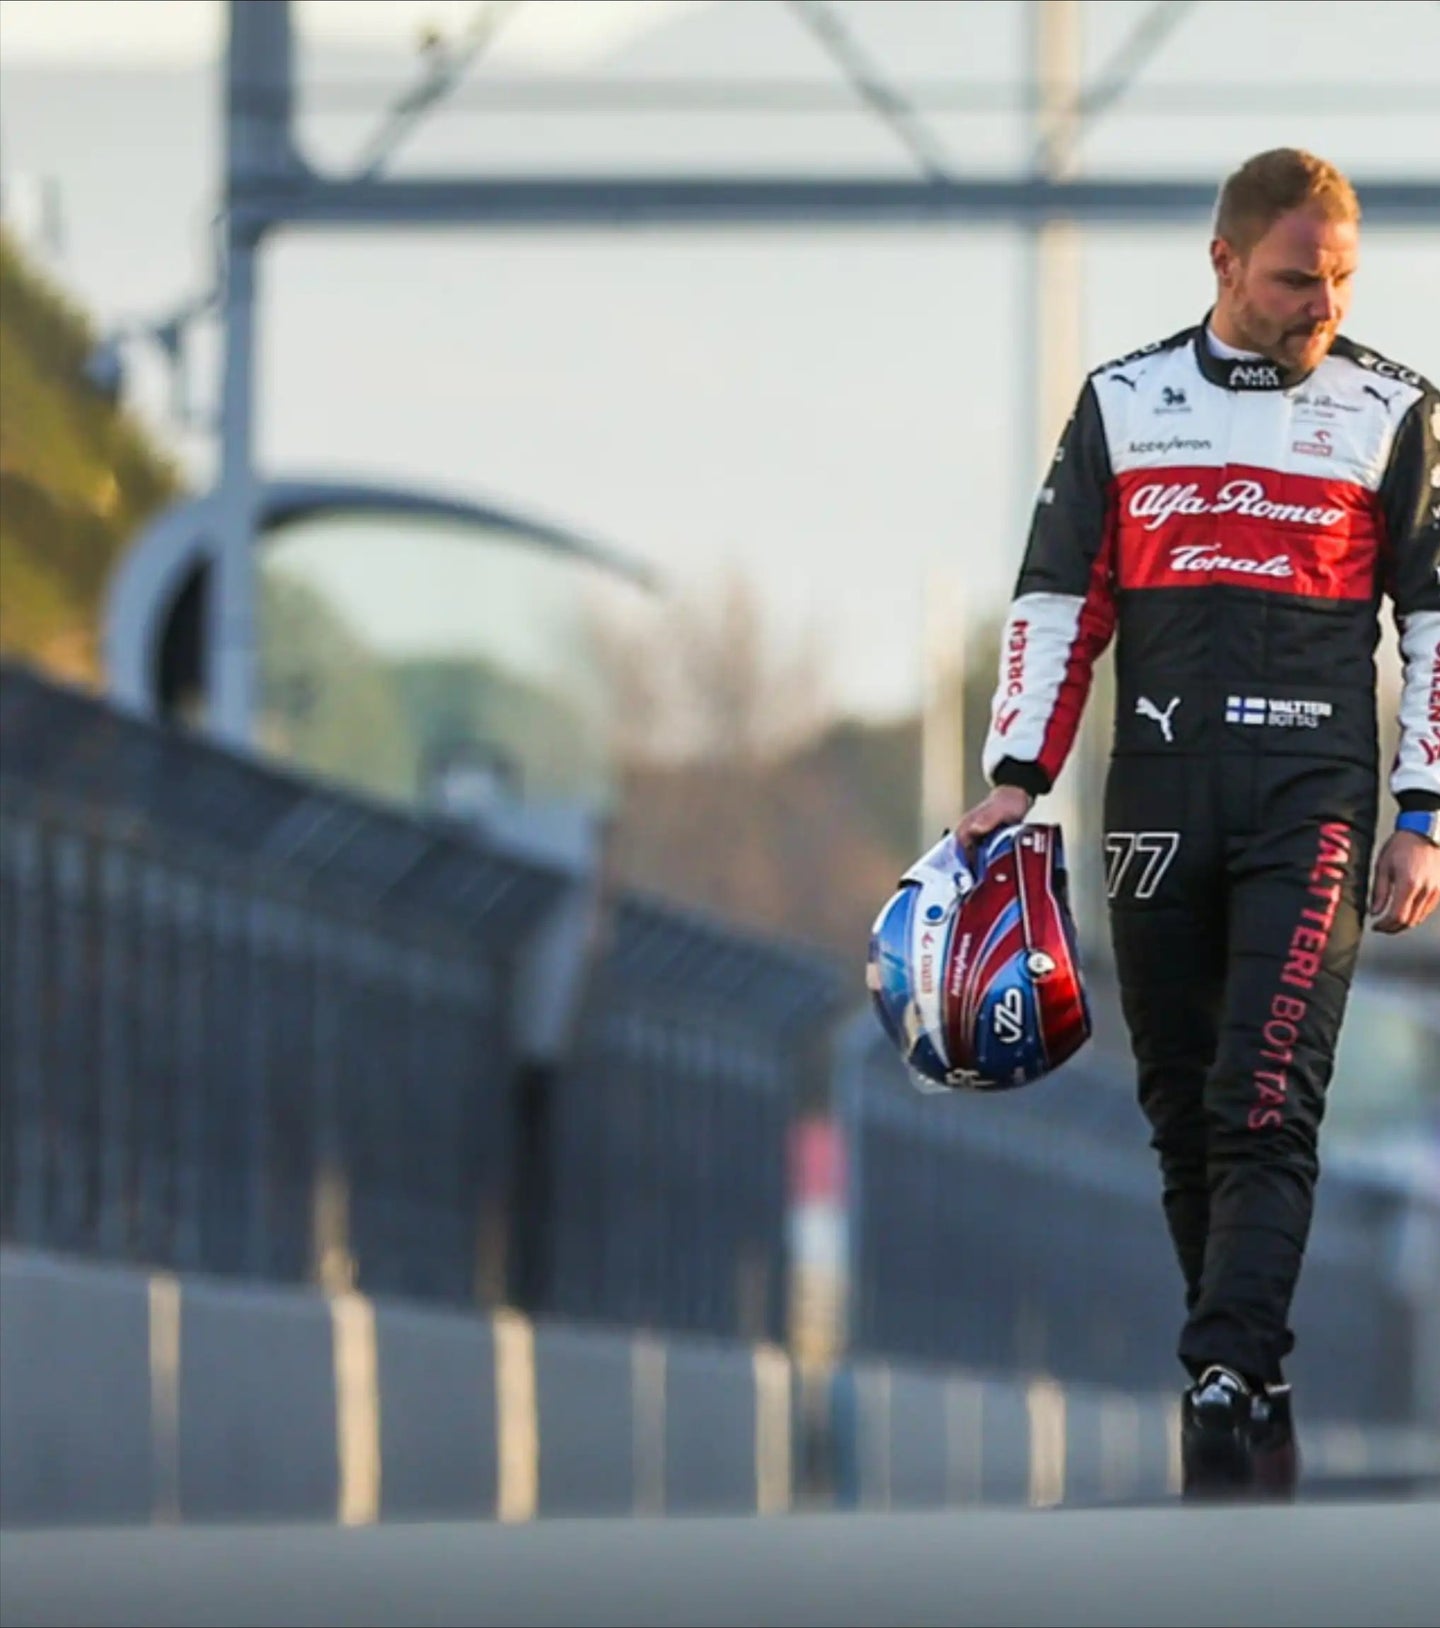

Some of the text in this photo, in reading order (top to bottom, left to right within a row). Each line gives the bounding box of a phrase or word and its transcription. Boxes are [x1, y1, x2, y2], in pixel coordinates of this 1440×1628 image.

[1229, 365, 1279, 386] AMX
[1128, 479, 1346, 531] Alfa Romeo
[1169, 542, 1294, 578] Tonale
[1105, 831, 1180, 899] 77
[1248, 821, 1351, 1131] VALTTERI BOTTAS
